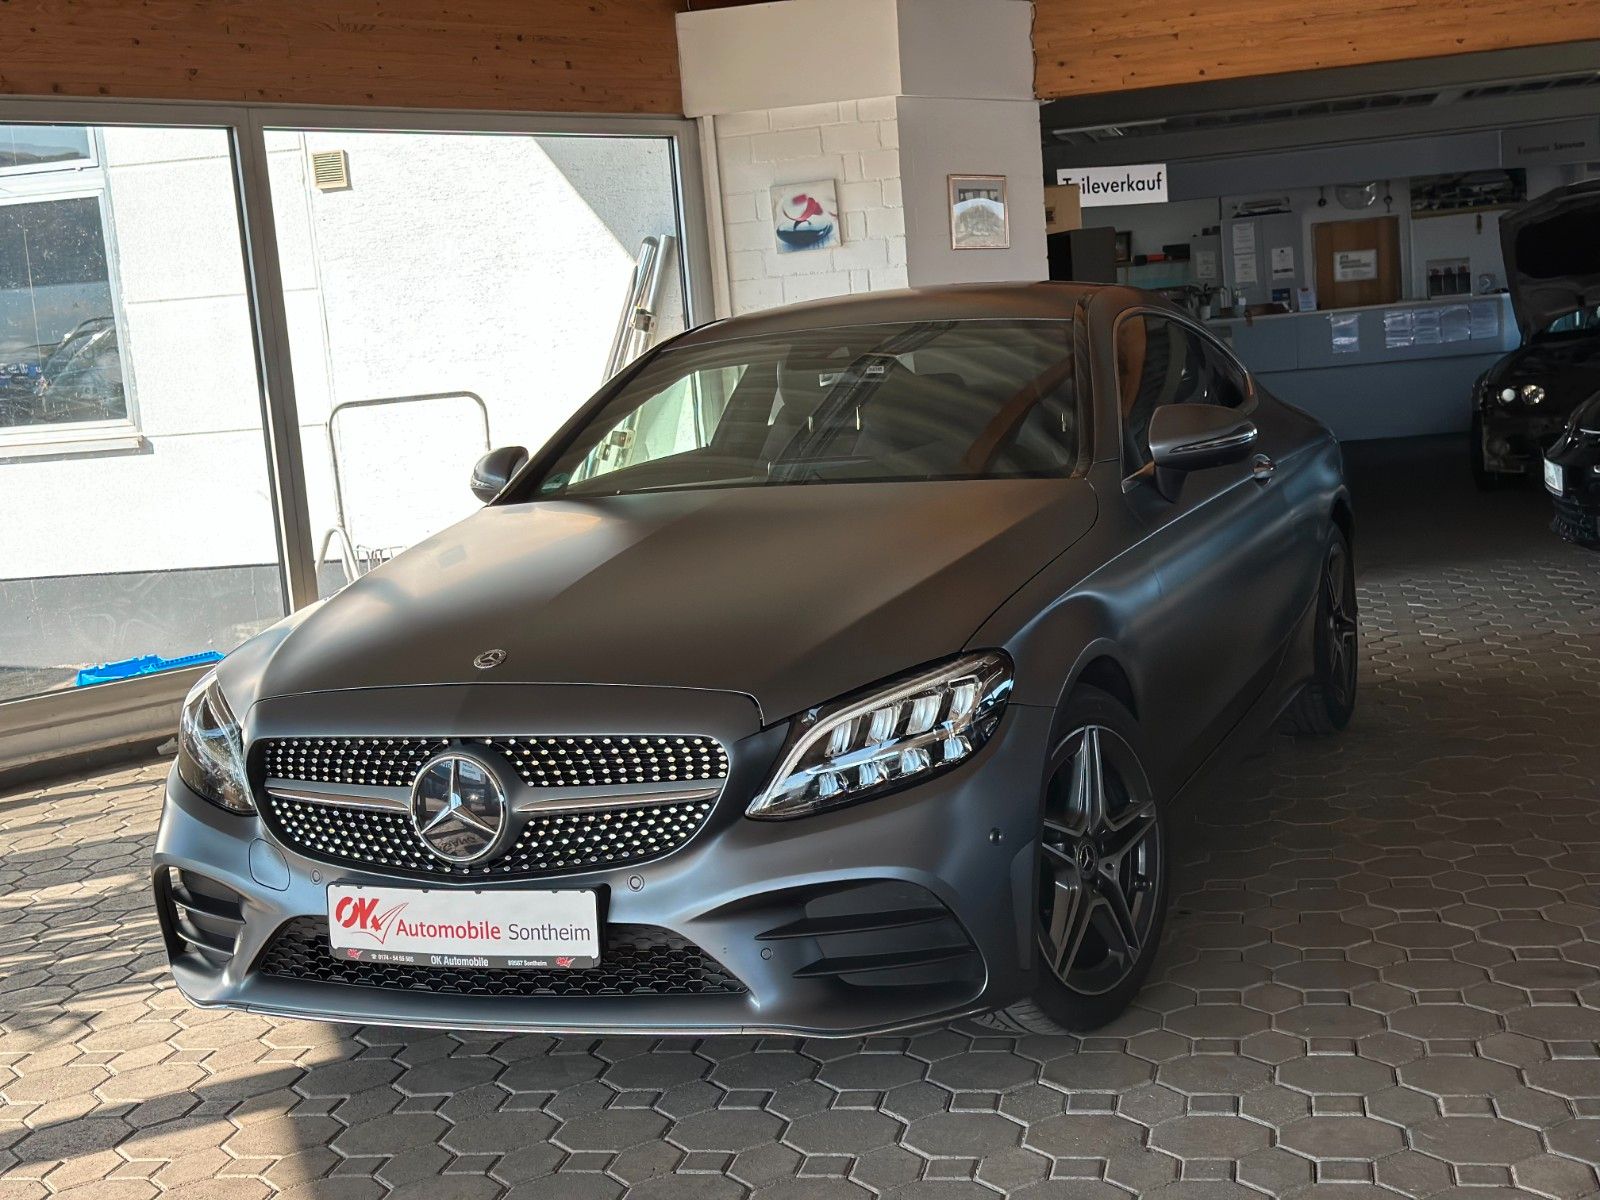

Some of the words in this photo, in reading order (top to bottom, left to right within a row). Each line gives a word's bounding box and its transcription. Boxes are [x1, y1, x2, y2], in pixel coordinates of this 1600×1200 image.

[1063, 171, 1162, 195] ileverkauf
[335, 896, 382, 932] OK
[396, 918, 502, 941] Automobile
[508, 923, 591, 941] Sontheim
[430, 955, 442, 965] OK
[443, 956, 489, 967] Automobile
[524, 959, 548, 967] Sontheim
